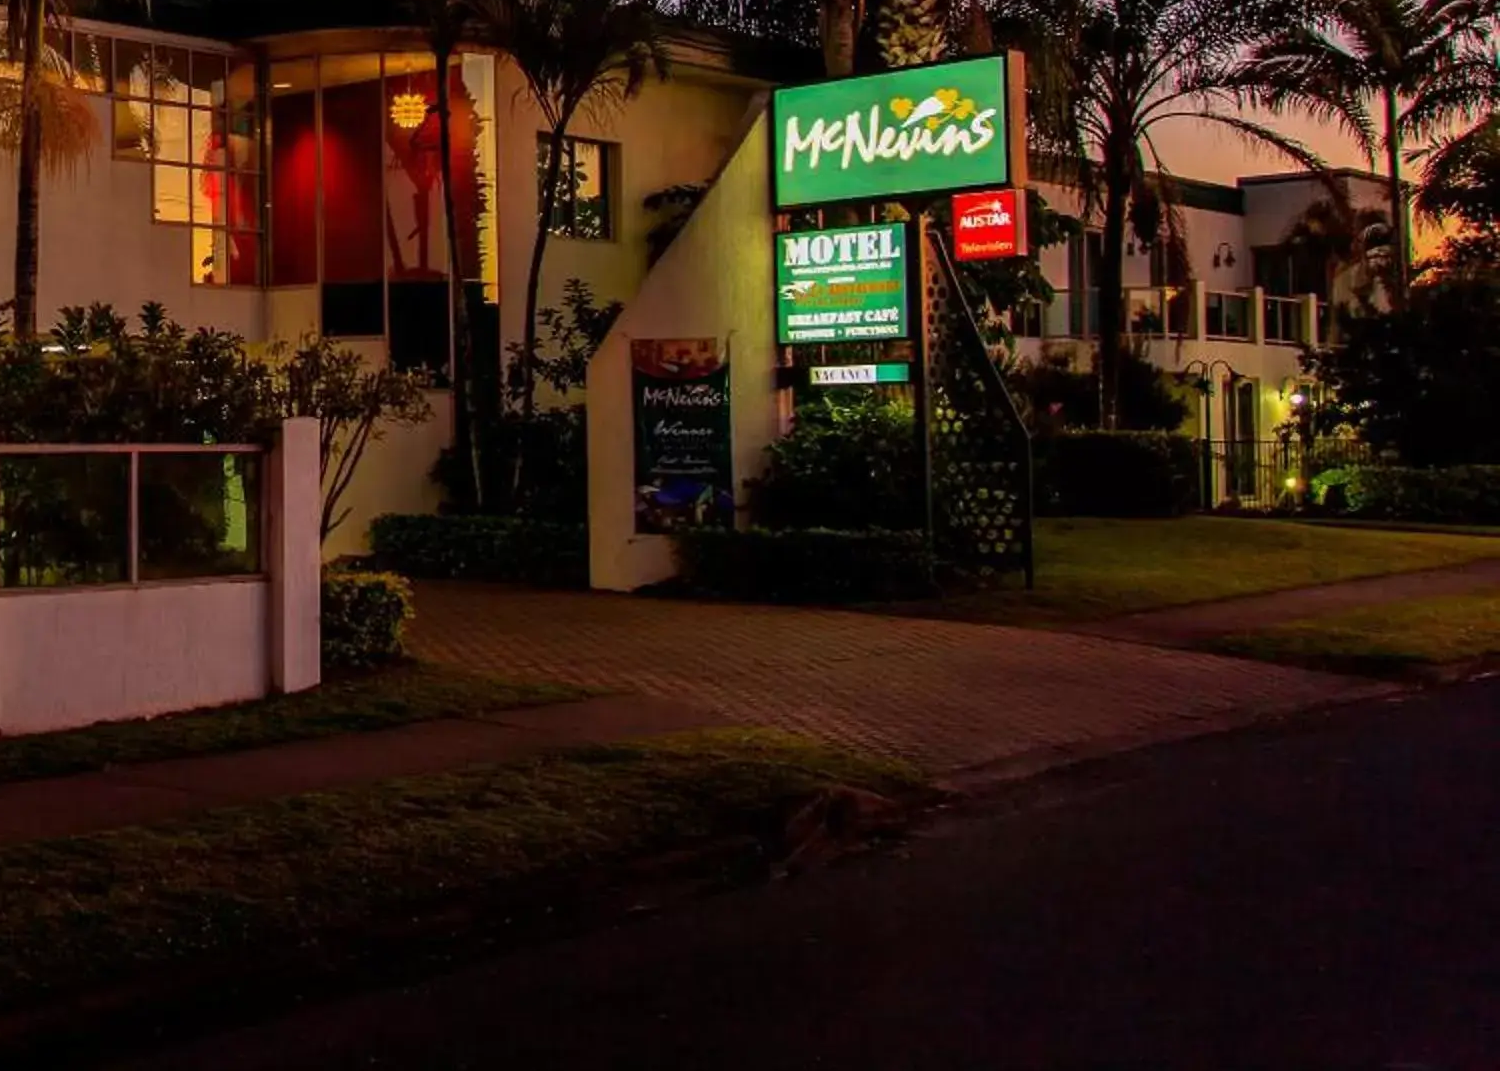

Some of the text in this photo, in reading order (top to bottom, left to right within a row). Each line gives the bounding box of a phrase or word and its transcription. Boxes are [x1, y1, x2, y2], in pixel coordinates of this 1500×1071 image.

[783, 105, 997, 172] McNevins
[959, 212, 1012, 230] AUSTAR
[783, 229, 901, 266] MOTEL
[814, 368, 870, 381] VACANCY
